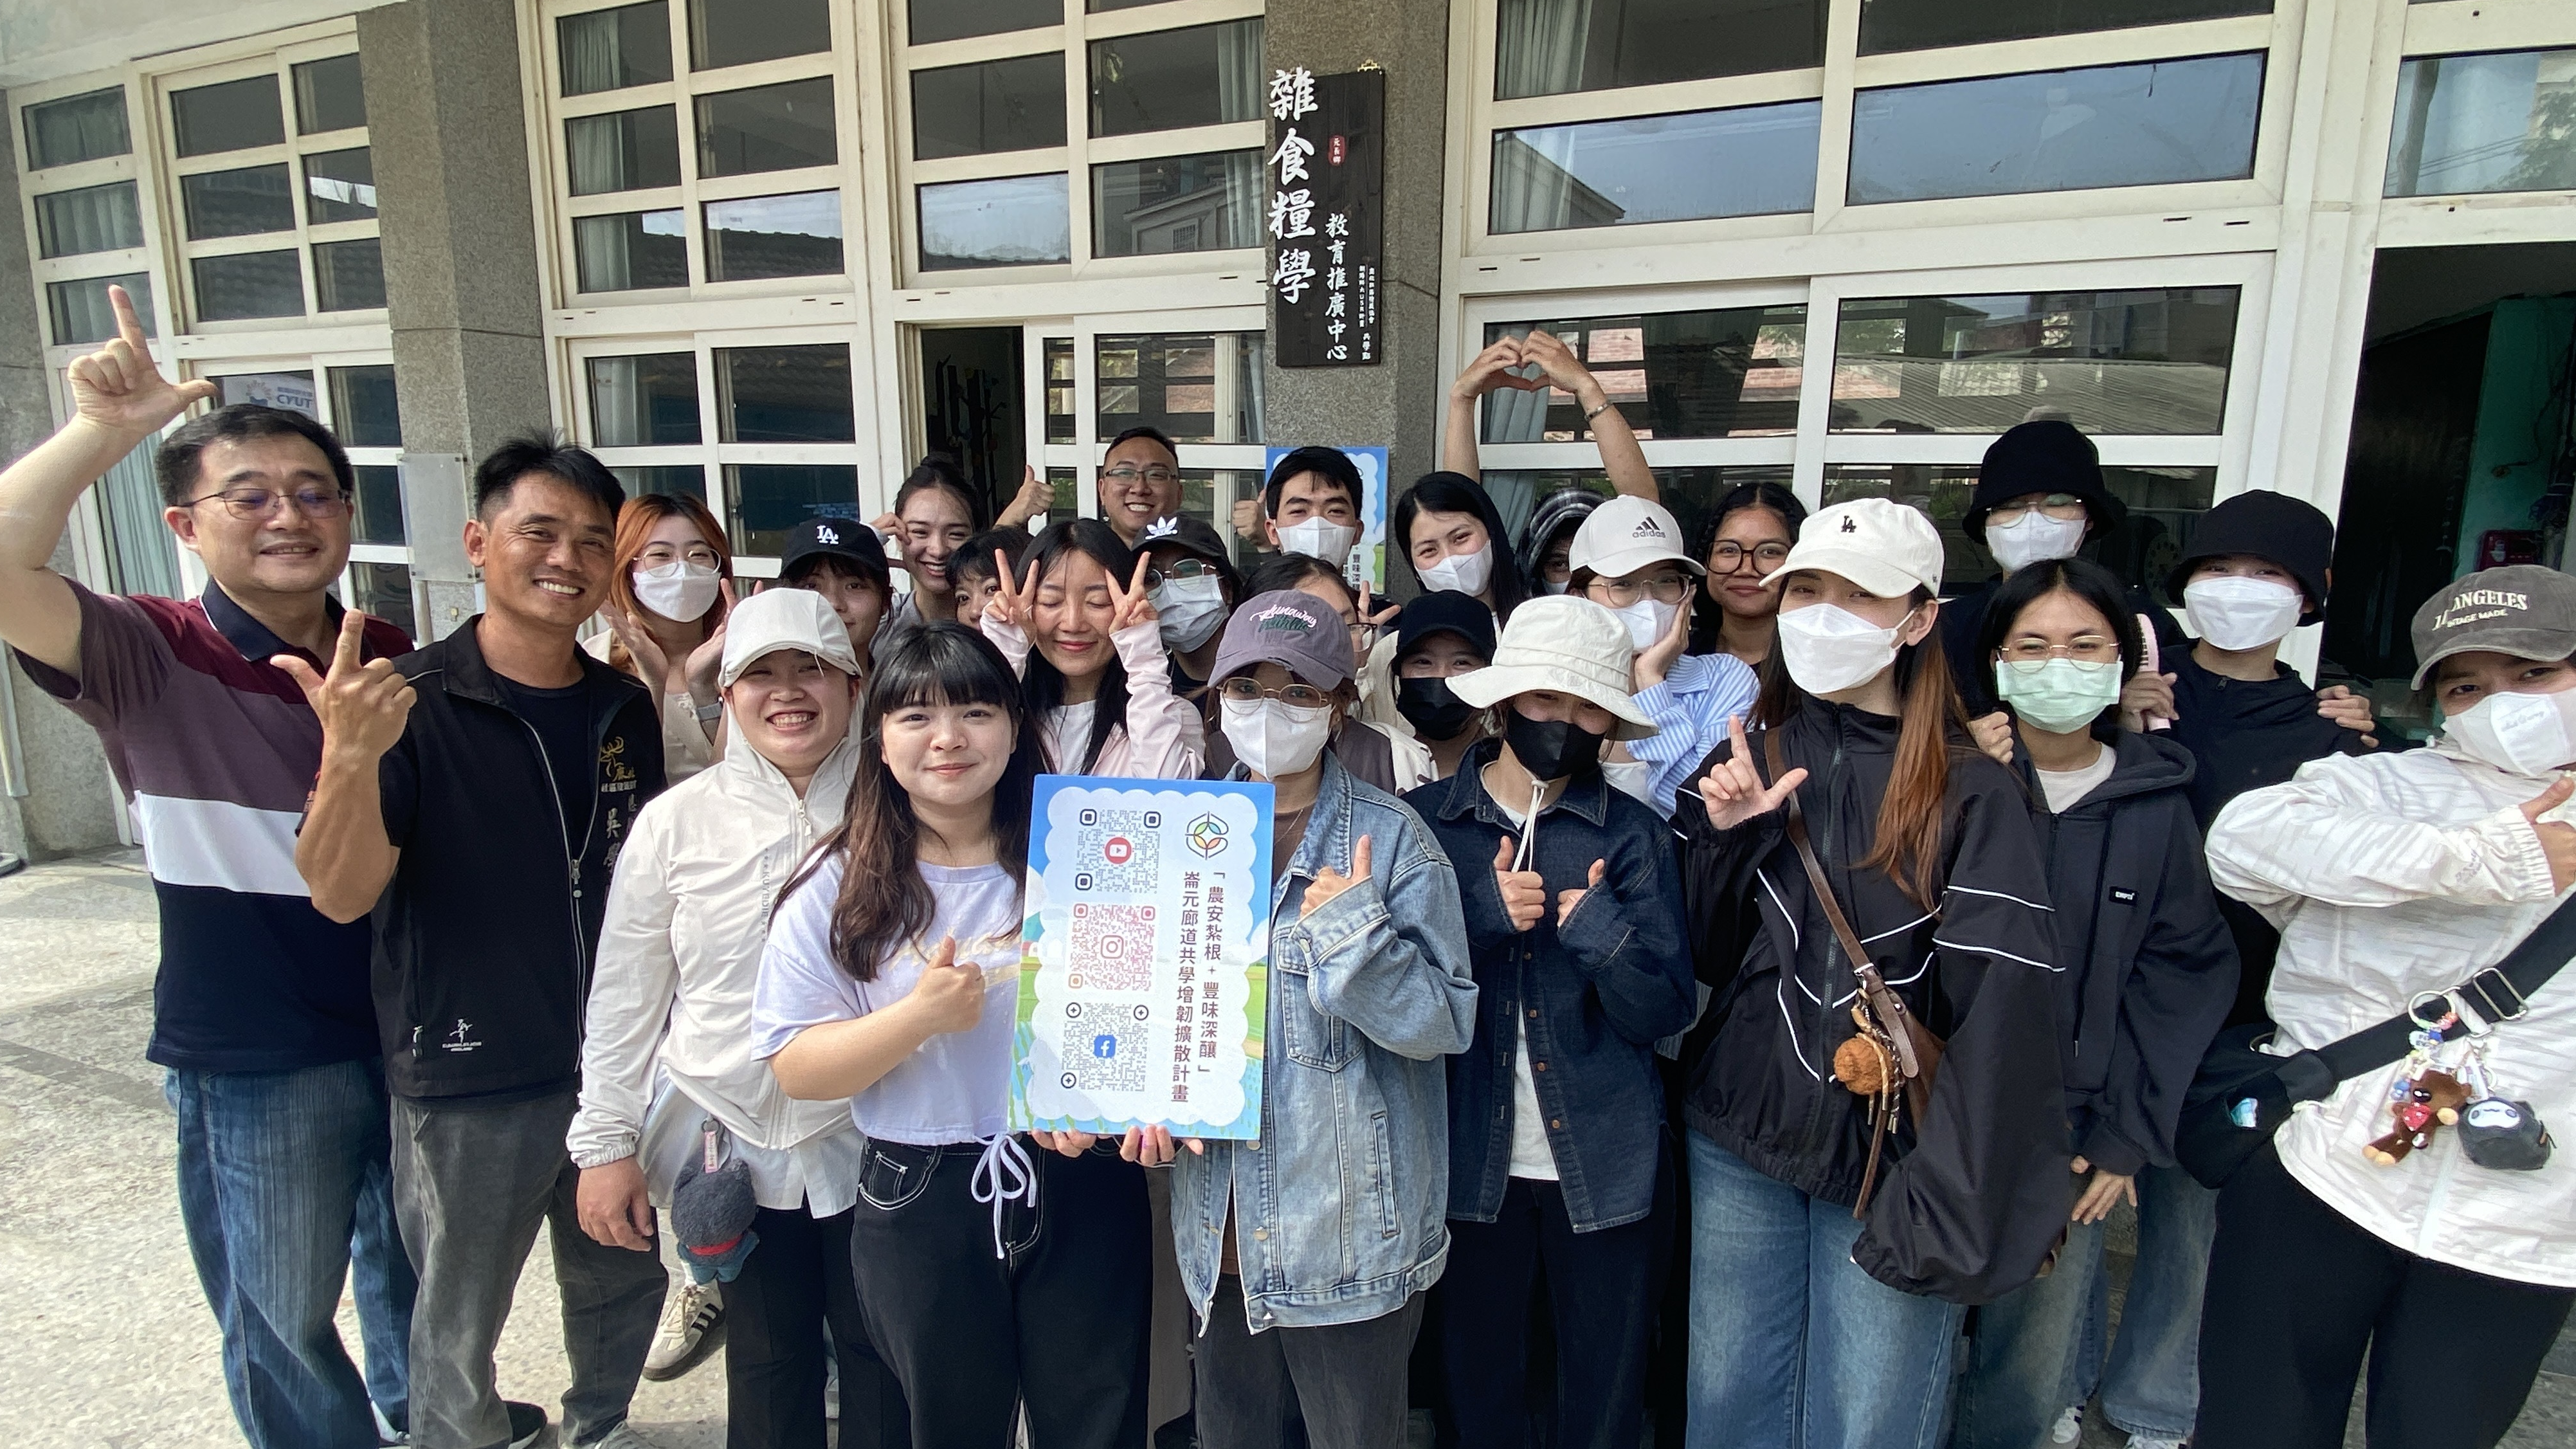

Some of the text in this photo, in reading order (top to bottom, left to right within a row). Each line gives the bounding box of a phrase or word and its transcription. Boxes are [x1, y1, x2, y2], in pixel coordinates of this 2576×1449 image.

[1268, 69, 1318, 304] 雜食糧學
[1325, 213, 1349, 361] 教育推廣中心
[277, 394, 312, 408] CYUT
[1632, 530, 1666, 538] adidas
[1841, 515, 1856, 533] LA
[817, 525, 839, 545] LA
[2451, 590, 2528, 610] ANGELES
[1171, 871, 1201, 1103] 崙元廊道共學增韌擴散計畫
